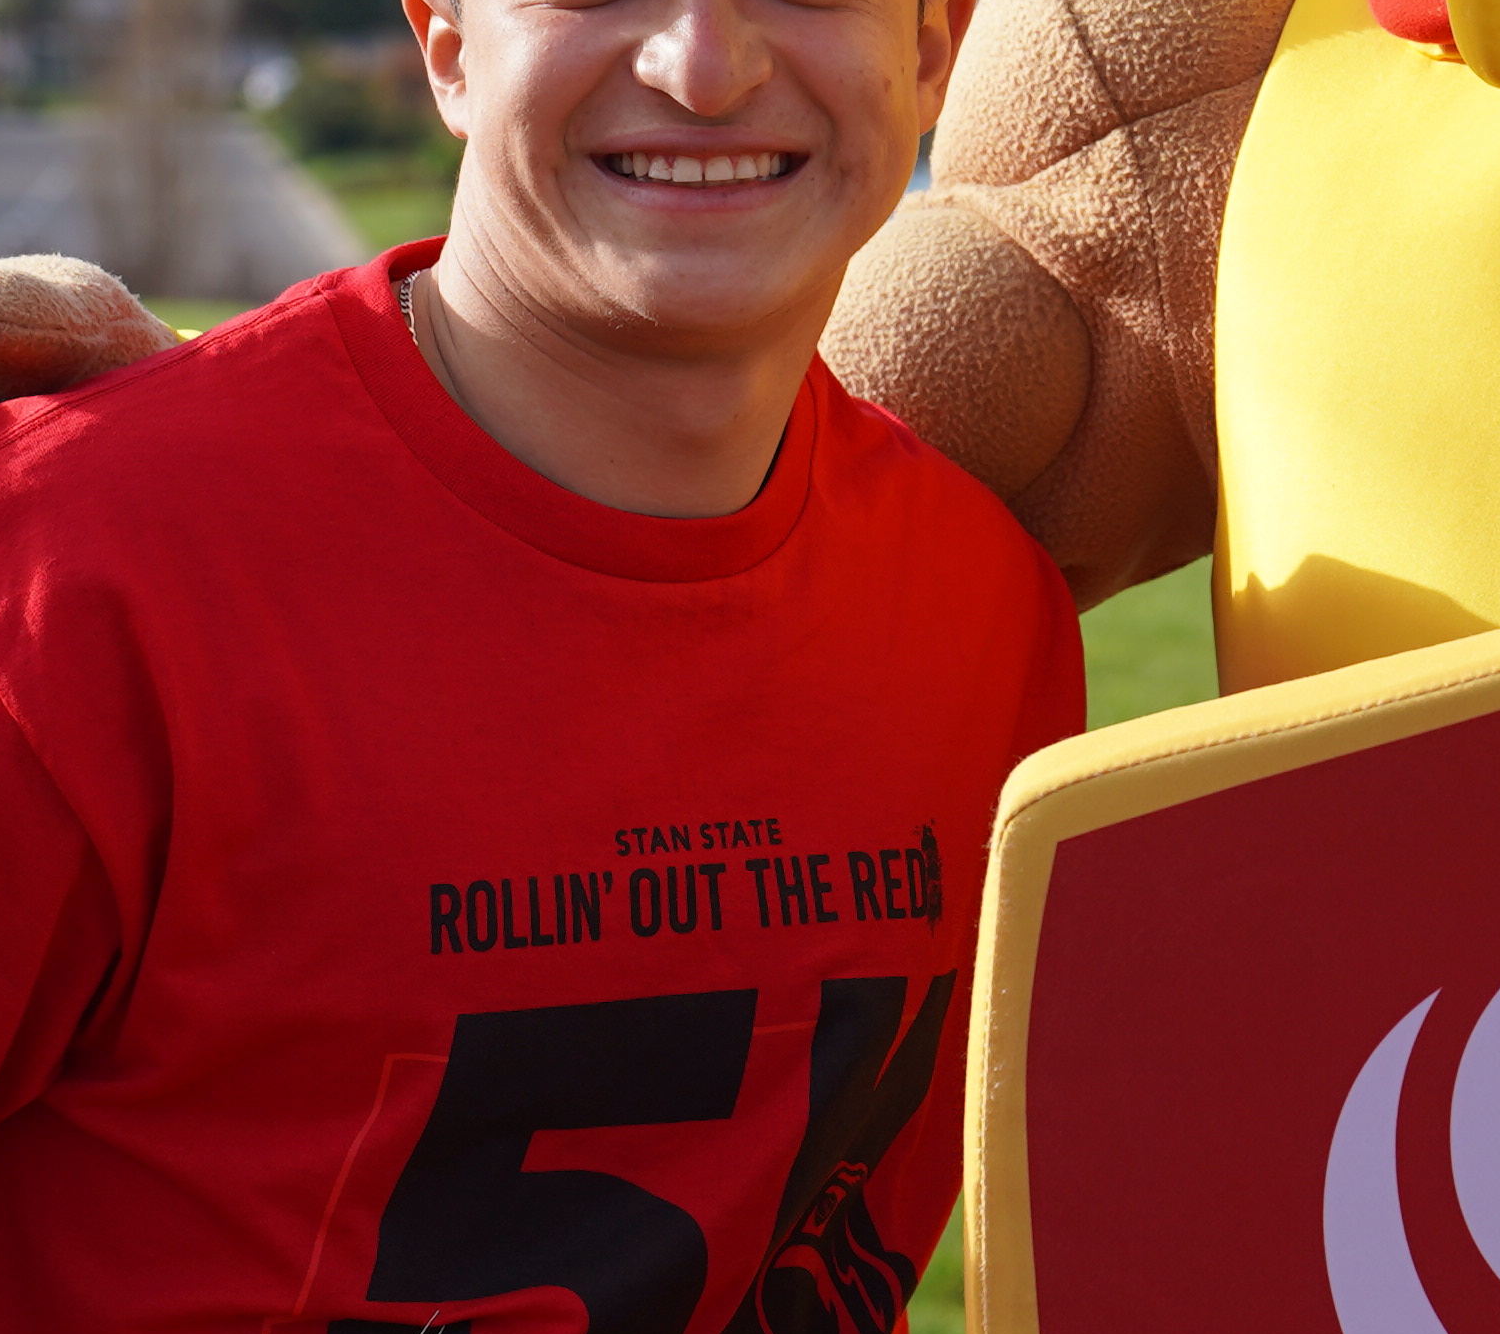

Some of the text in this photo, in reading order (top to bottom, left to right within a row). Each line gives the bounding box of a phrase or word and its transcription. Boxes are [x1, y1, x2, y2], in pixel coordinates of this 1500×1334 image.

[614, 817, 783, 857] STAN STATE
[430, 847, 930, 955] ROLLIN' OUT THE RED
